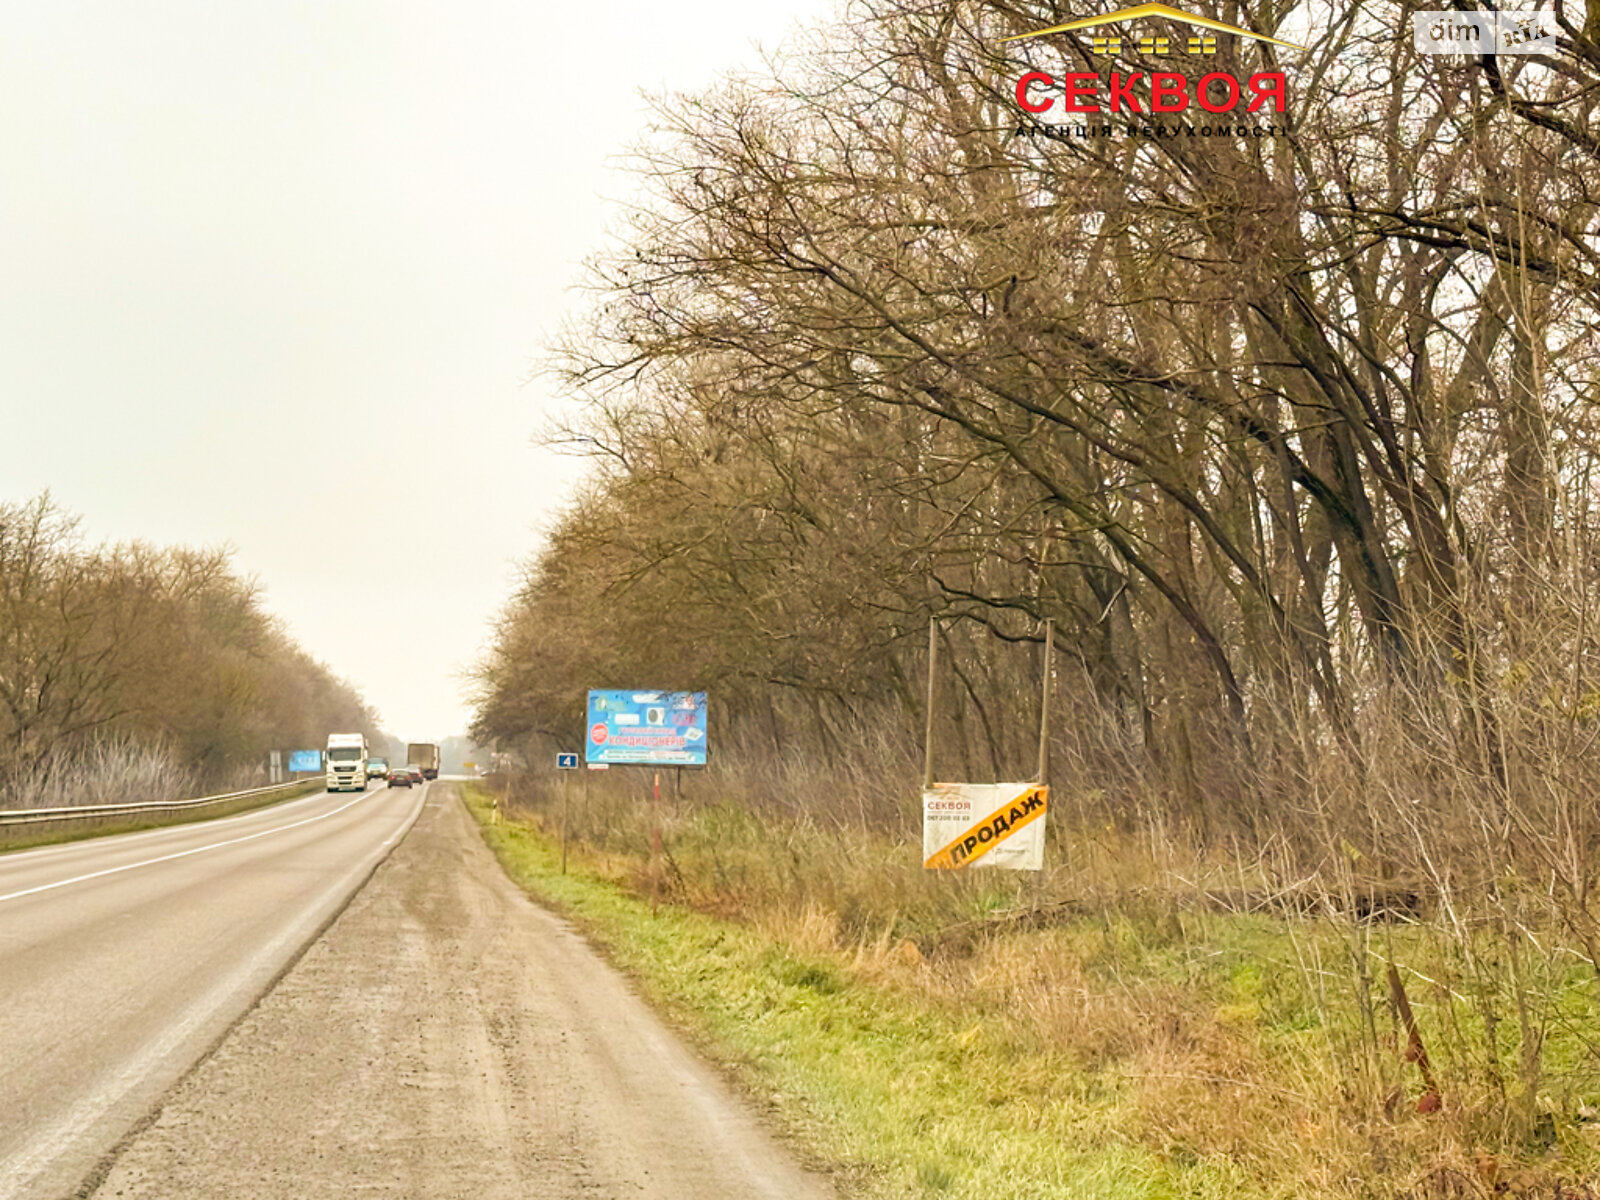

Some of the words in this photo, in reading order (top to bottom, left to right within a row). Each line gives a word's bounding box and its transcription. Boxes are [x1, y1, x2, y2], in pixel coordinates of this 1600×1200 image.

[562, 756, 571, 767] 4
[927, 801, 971, 810] СЕКВОЯ
[950, 791, 1043, 864] ПРОДАЖ
